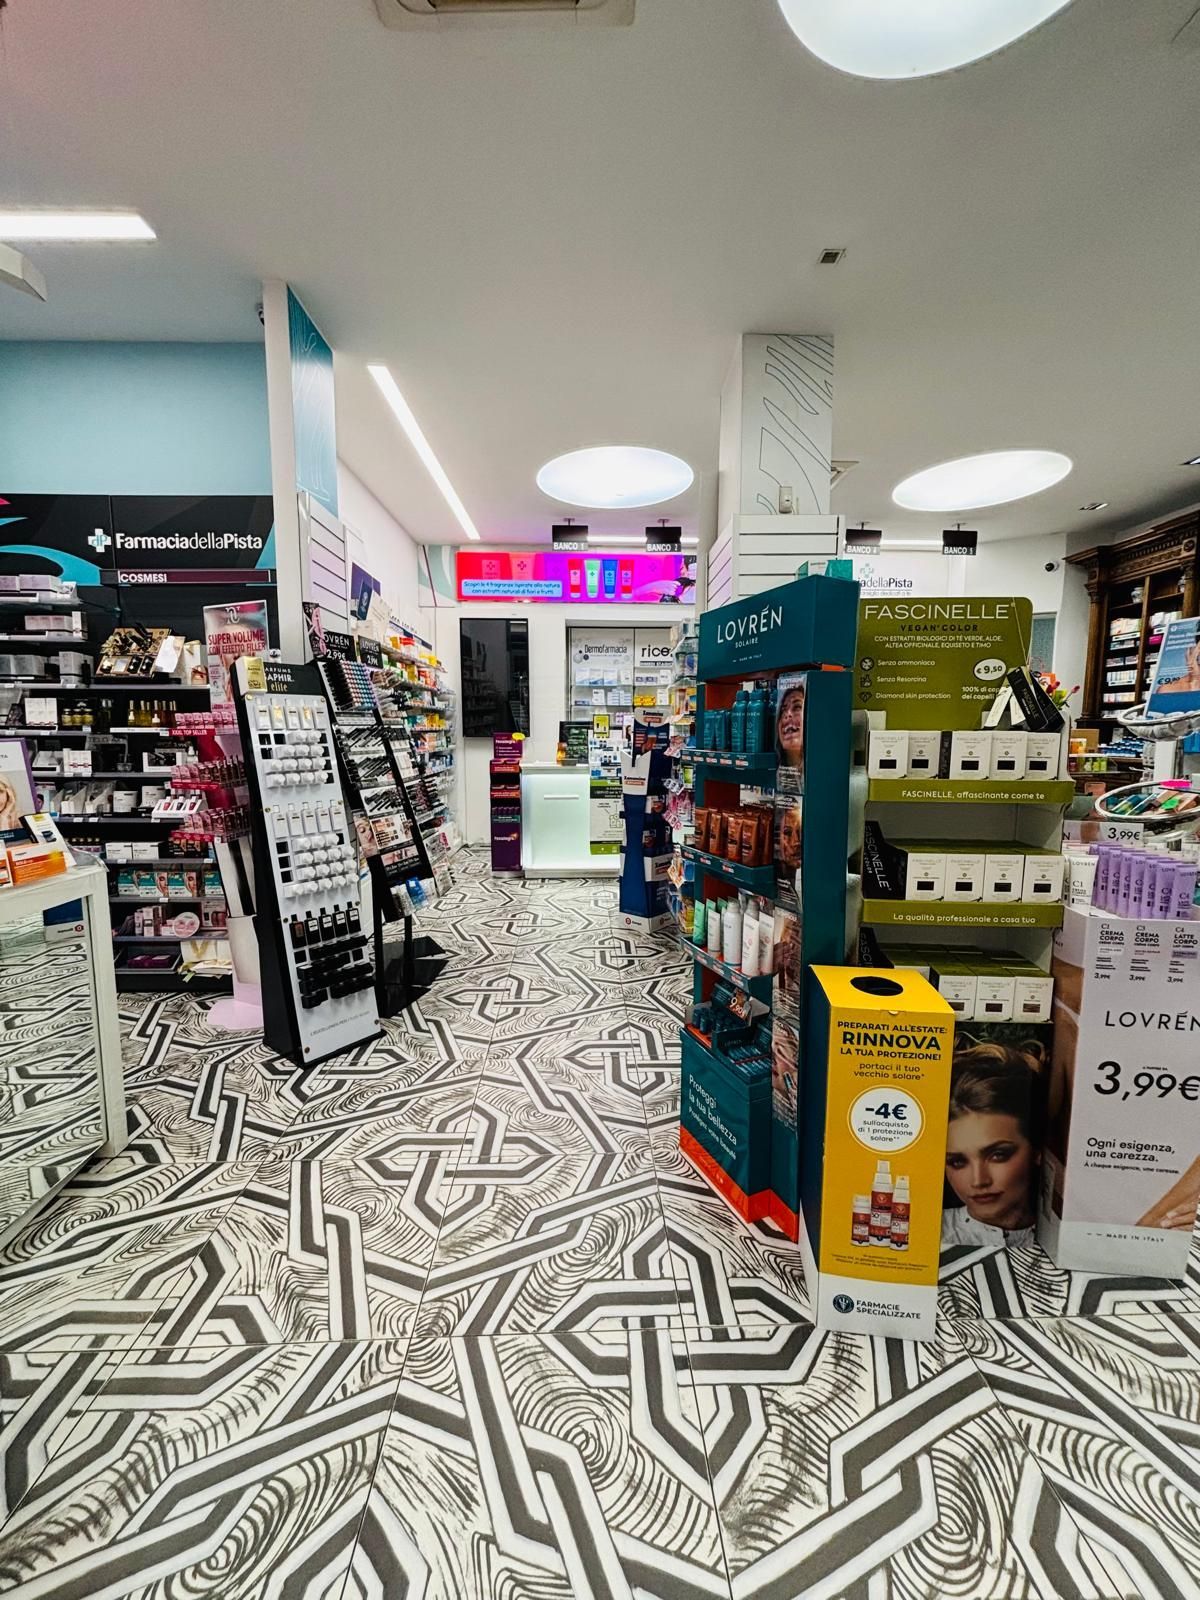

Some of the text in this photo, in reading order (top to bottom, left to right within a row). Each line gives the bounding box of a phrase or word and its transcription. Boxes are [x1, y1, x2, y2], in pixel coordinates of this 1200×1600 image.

[115, 532, 263, 550] FarmaciadellaPista
[553, 541, 578, 550] BANCO
[646, 543, 671, 552] BANCO
[846, 545, 871, 554] BANCO
[943, 546, 968, 554] BANCO
[120, 573, 168, 583] COSMESI
[864, 604, 1010, 620] FASCINELLE
[717, 605, 784, 644] LOVRÉN
[942, 624, 979, 632] COLOR
[208, 629, 265, 645] SUPER VOLUME
[324, 633, 350, 646] OVRÉN
[735, 636, 759, 648] SOLAIRE
[208, 641, 267, 655] CON EFFETTO FILLER
[584, 644, 628, 654] Dermofarmacia
[326, 649, 346, 661] 2,99€
[983, 665, 1004, 675] 9,50
[270, 681, 288, 693] elite
[875, 692, 951, 701] Diamond skin protection
[970, 693, 994, 702] capelli
[902, 790, 1045, 800] FASCINELLE, affascinante come te
[1107, 827, 1141, 841] 3,99€
[893, 913, 904, 921] La
[905, 913, 935, 923] qualità
[936, 913, 991, 923] professionale
[1021, 916, 1036, 924] tua
[837, 1021, 948, 1034] PREPARATI ALL'ESTATE:
[842, 1031, 941, 1051] RINNOVA
[840, 1047, 942, 1061] LA TUA PROTEZIONE!
[859, 1062, 893, 1073] portaci
[895, 1063, 901, 1071] il
[854, 1070, 890, 1079] vecchio
[1093, 1060, 1200, 1101] 3,99€
[689, 1074, 718, 1109] Proteggi
[688, 1089, 738, 1146] la tua bellezza
[865, 1102, 908, 1121] -4€
[863, 1120, 910, 1129] sull'acquisto
[872, 1128, 914, 1137] protezione
[1087, 1137, 1176, 1154] Ogni esigenza,
[1085, 1150, 1159, 1163] una carezza.
[1090, 1162, 1112, 1170] chaque
[1106, 1232, 1128, 1240] MADE
[856, 1300, 900, 1311] FARMACIE
[856, 1307, 921, 1320] SPECIALIZZATE
